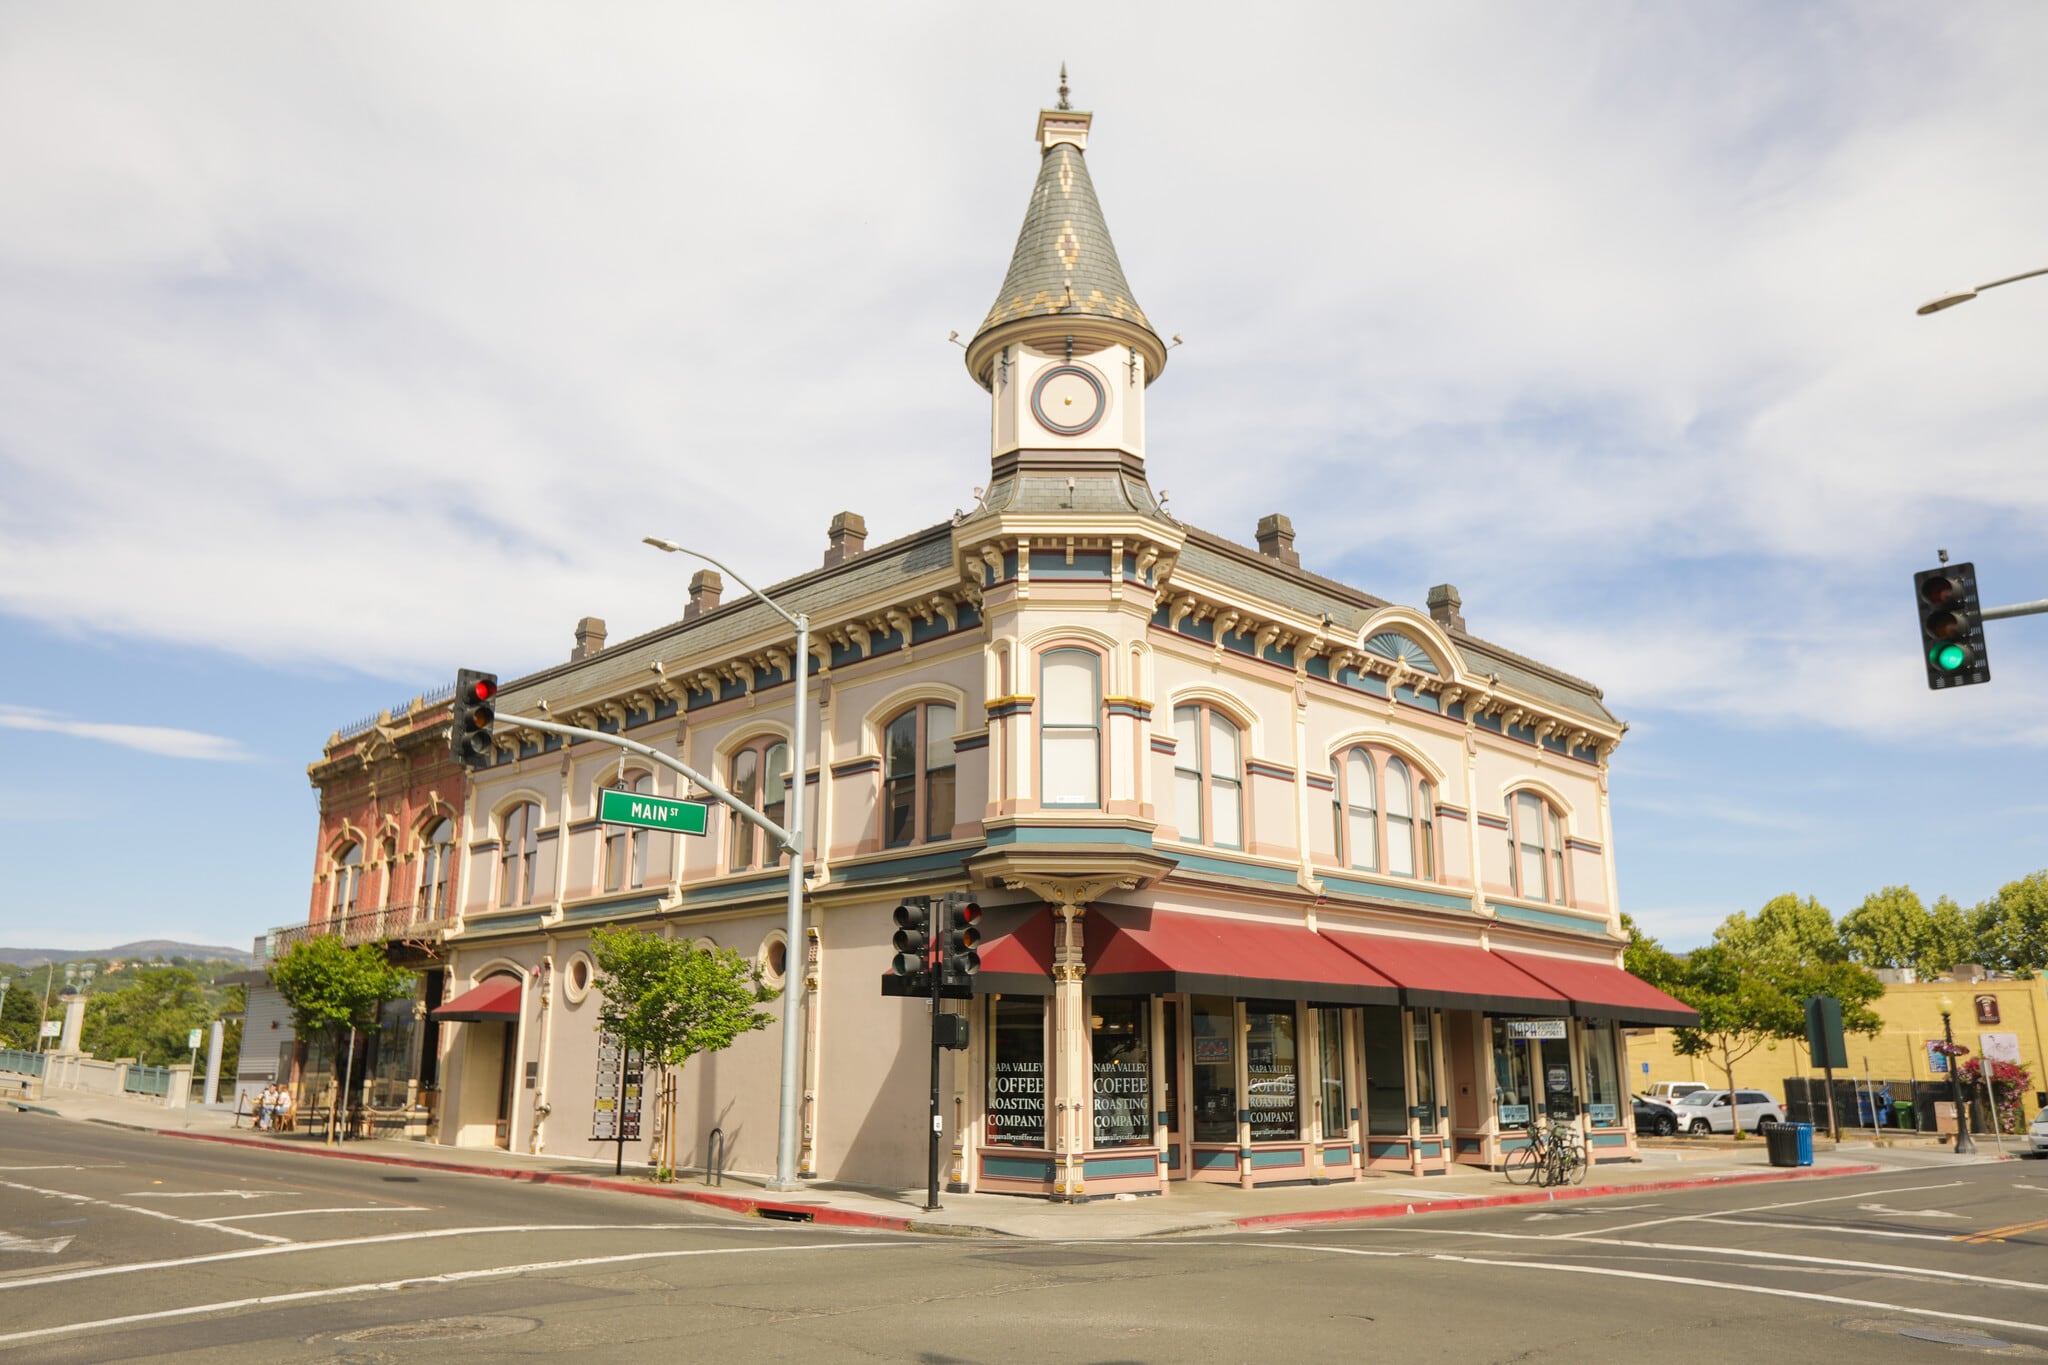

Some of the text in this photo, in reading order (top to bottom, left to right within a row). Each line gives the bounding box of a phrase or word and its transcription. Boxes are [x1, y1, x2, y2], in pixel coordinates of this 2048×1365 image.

[631, 801, 679, 822] MAIN ST
[1508, 1022, 1537, 1038] NAPA
[988, 1062, 1044, 1073] APA VALLEY
[1094, 1062, 1147, 1073] NAPA VALLEY
[1249, 1065, 1292, 1073] NAPA VALLEY
[988, 1077, 1044, 1094] COFFEE
[1094, 1077, 1148, 1094] COFFEE
[1250, 1078, 1294, 1092] COFFEE
[988, 1097, 1045, 1110] ROASTING
[1094, 1098, 1149, 1111] ROASTING
[1250, 1096, 1294, 1108] ROASTING
[988, 1114, 1044, 1127] COMPANY
[1095, 1114, 1149, 1128] COMPANY
[1250, 1111, 1295, 1123] COMPANY
